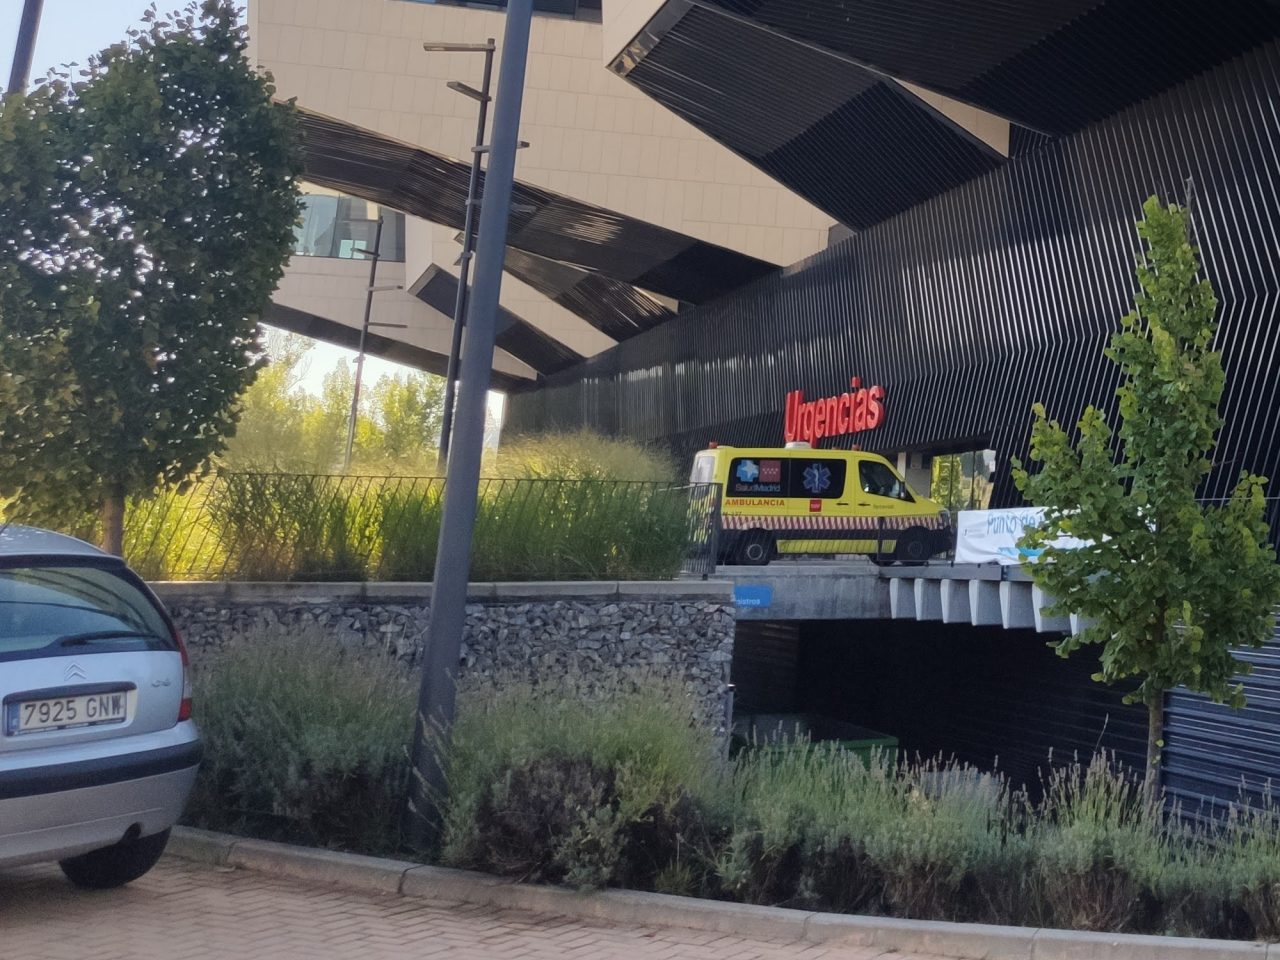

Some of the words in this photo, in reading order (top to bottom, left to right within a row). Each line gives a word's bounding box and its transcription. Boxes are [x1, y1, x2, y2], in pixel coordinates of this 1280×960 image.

[784, 376, 885, 448] Urgencias
[725, 498, 785, 507] AMBULANCIA
[986, 513, 1017, 535] Punto
[24, 699, 77, 726] 7925
[86, 695, 121, 718] GNW
